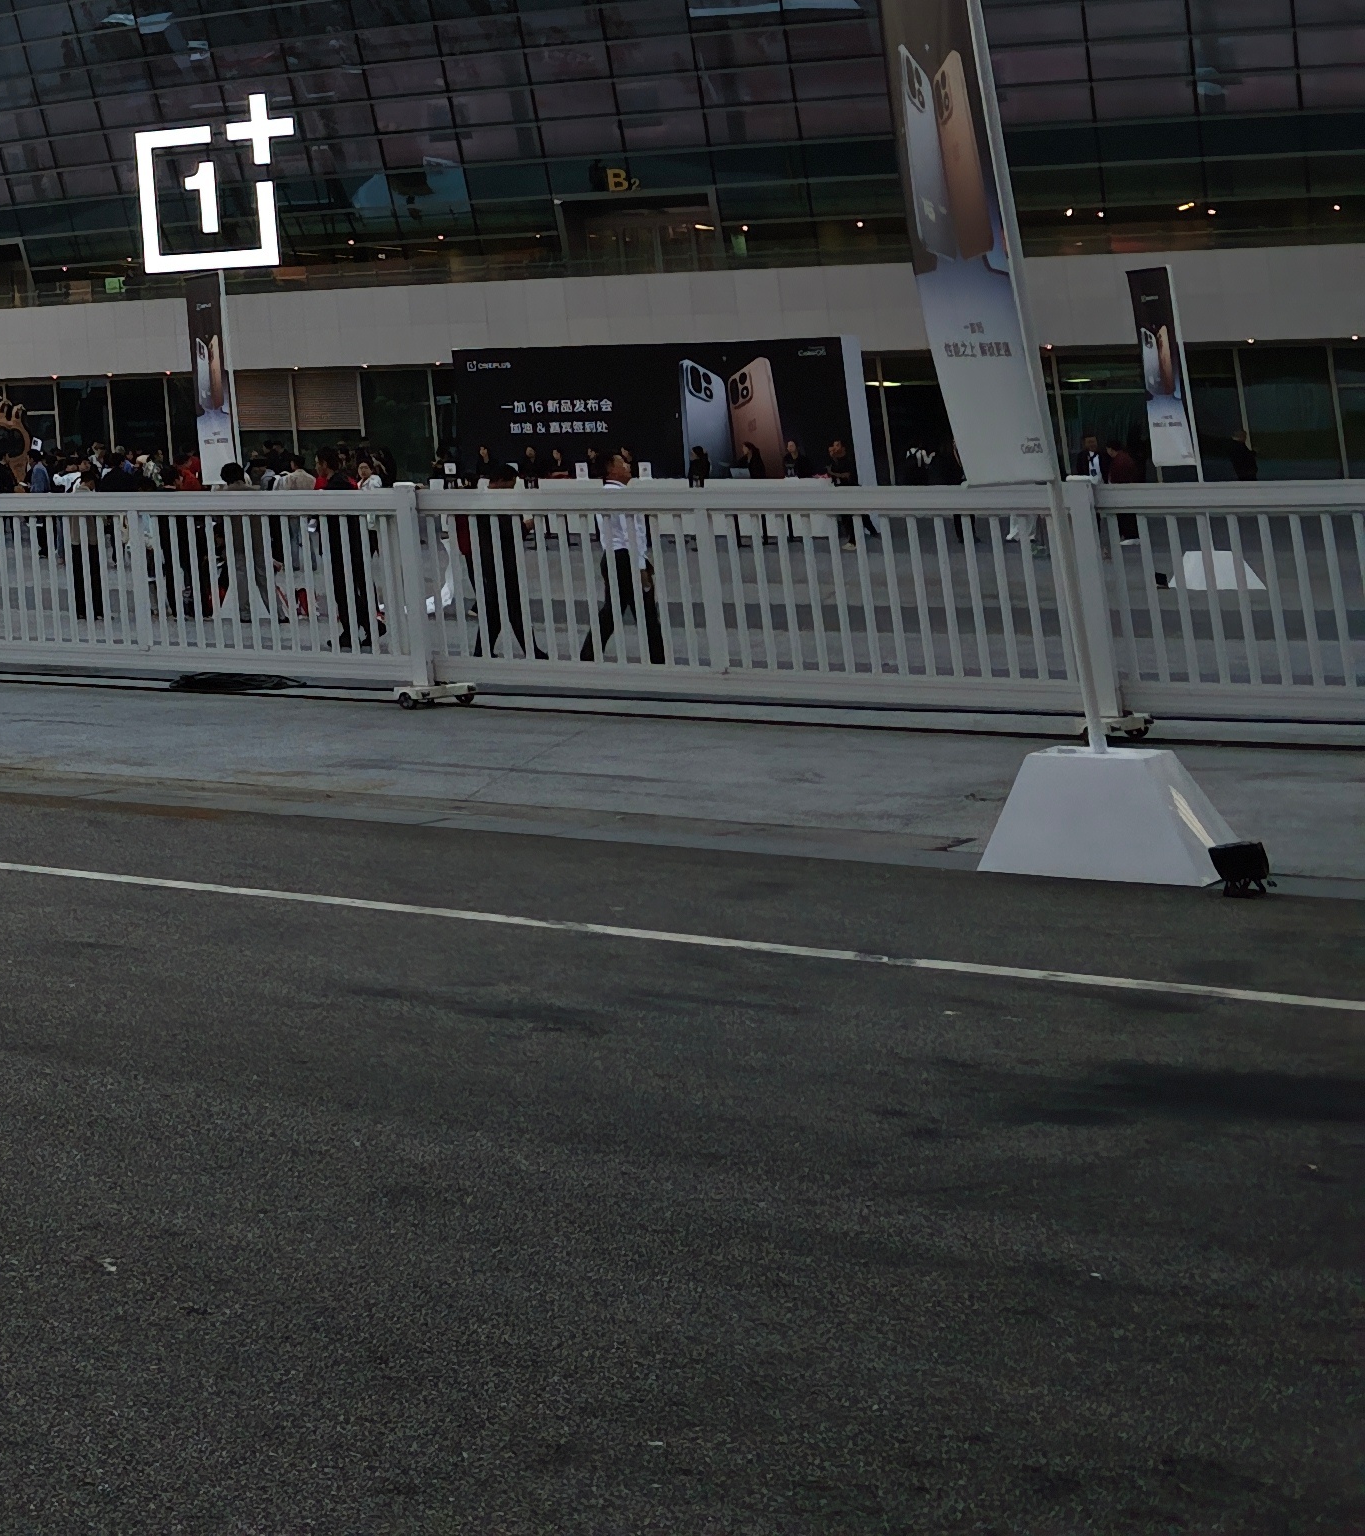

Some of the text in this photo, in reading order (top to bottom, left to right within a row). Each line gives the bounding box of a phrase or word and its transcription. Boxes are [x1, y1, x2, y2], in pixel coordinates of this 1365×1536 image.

[500, 399, 613, 413] 一加 16 新品发布会
